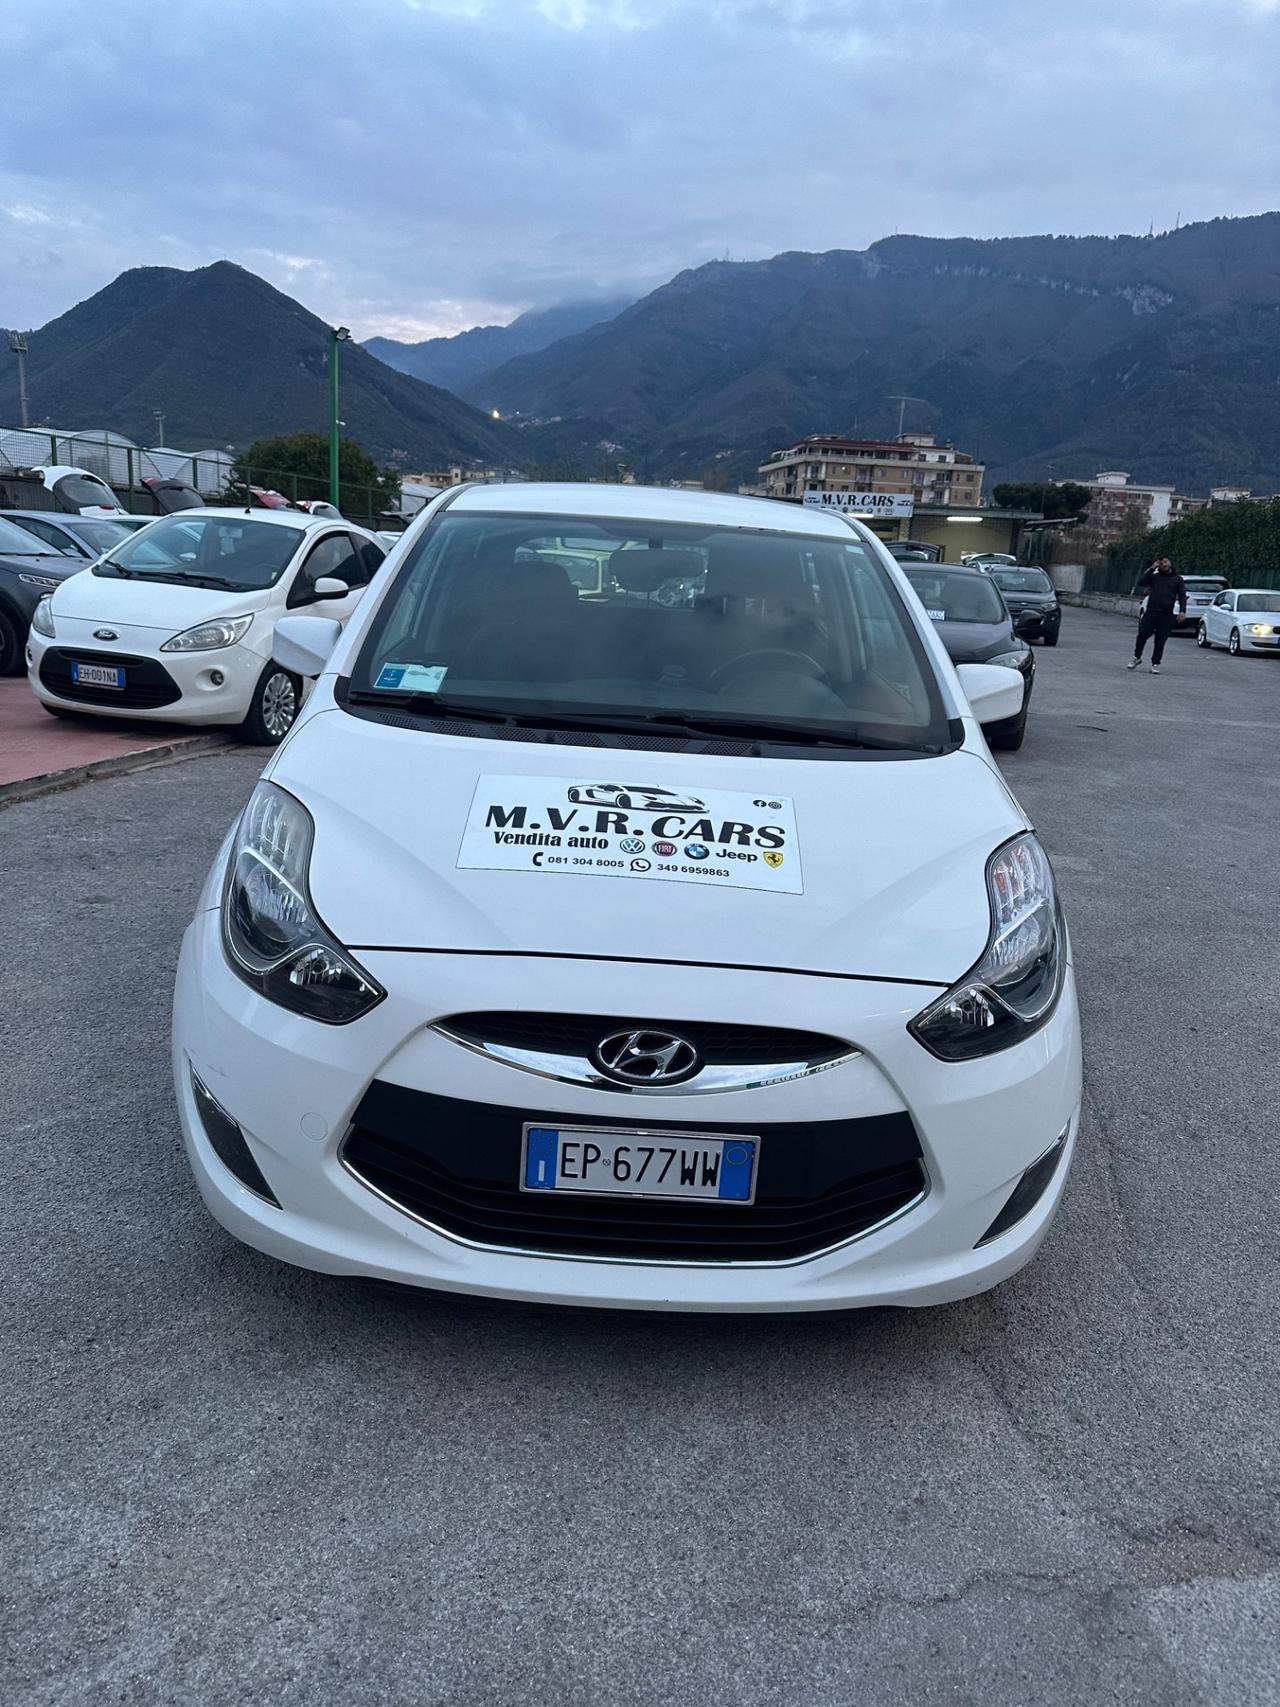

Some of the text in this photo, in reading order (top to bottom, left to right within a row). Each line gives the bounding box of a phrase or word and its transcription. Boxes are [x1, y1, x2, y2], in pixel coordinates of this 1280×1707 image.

[927, 609, 943, 617] UTO
[493, 830, 609, 850] Vendita auto
[547, 856, 625, 868] 081 304 8005
[715, 848, 758, 863] Jeep
[657, 863, 730, 878] 349 6959863
